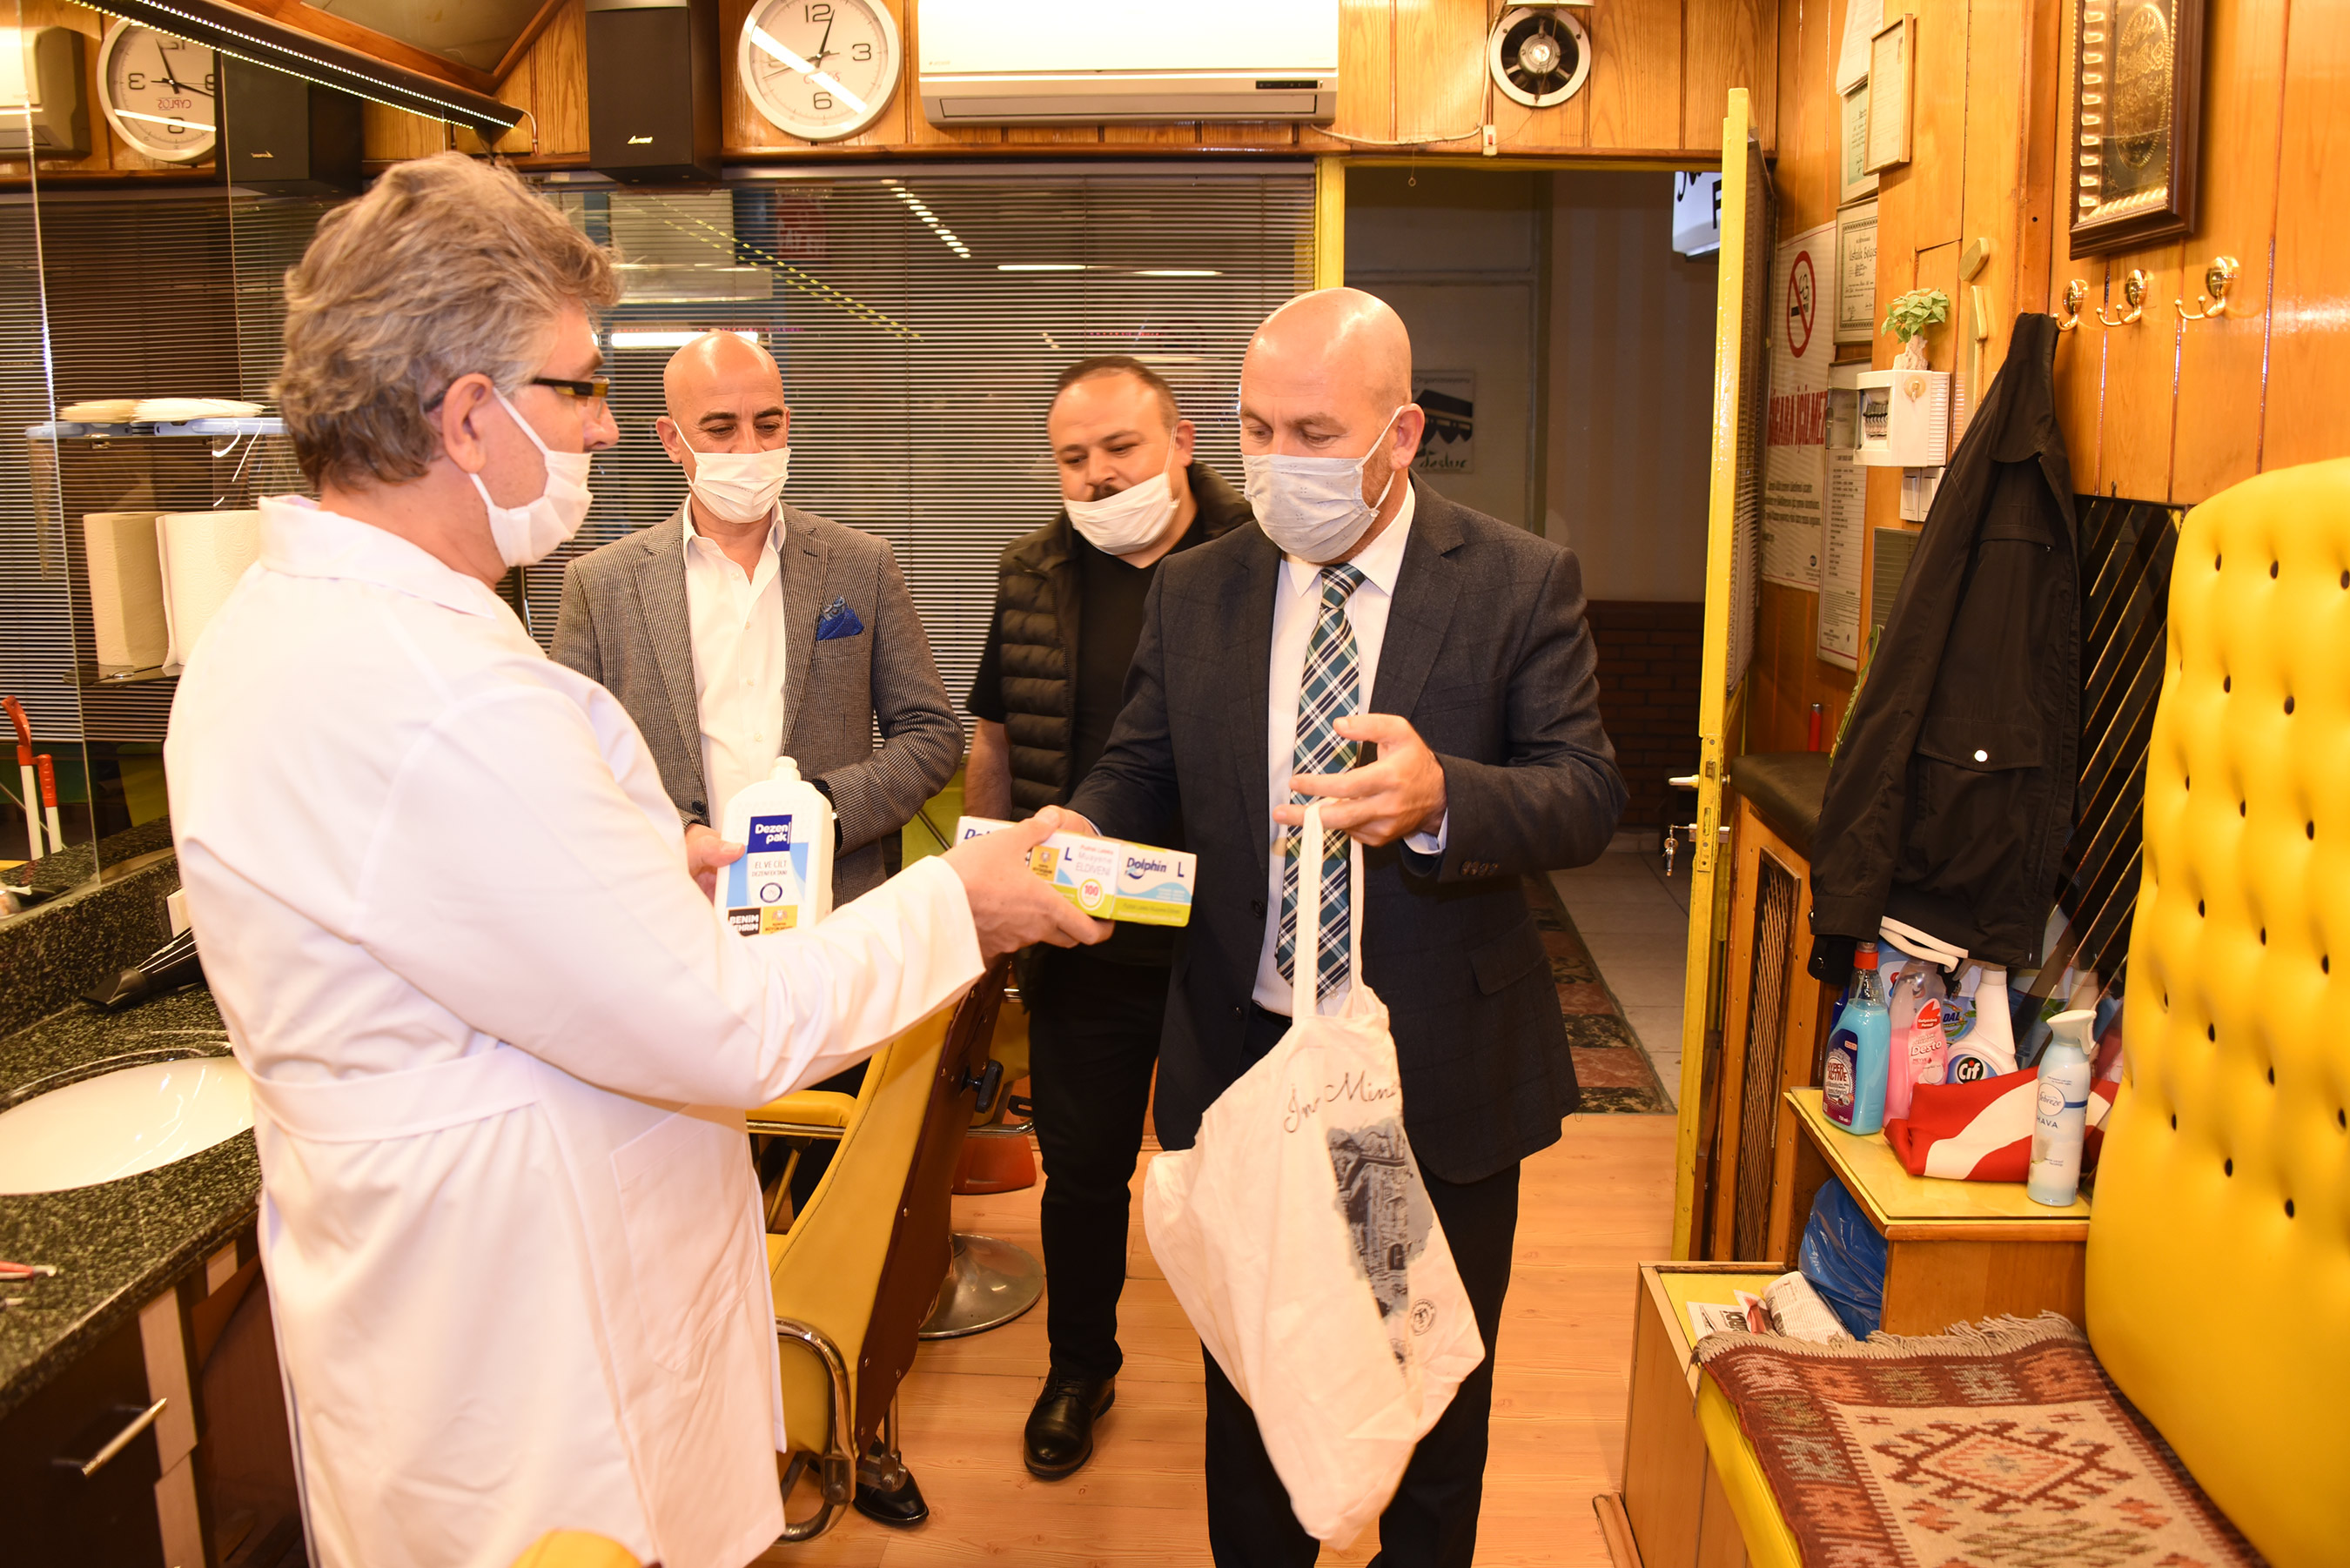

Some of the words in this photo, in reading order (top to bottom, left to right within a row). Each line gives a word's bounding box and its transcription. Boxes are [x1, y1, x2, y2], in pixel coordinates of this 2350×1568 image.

[805, 3, 832, 23] 12
[852, 43, 871, 61] 3
[813, 92, 832, 110] 6
[755, 823, 789, 834] Dezen
[766, 833, 787, 844] pak
[1064, 847, 1072, 861] L
[1127, 857, 1167, 874] Dolphin
[1178, 861, 1185, 878] L
[1084, 885, 1099, 897] 100
[1911, 1041, 1942, 1056] Desto
[1958, 1060, 1981, 1081] Cif
